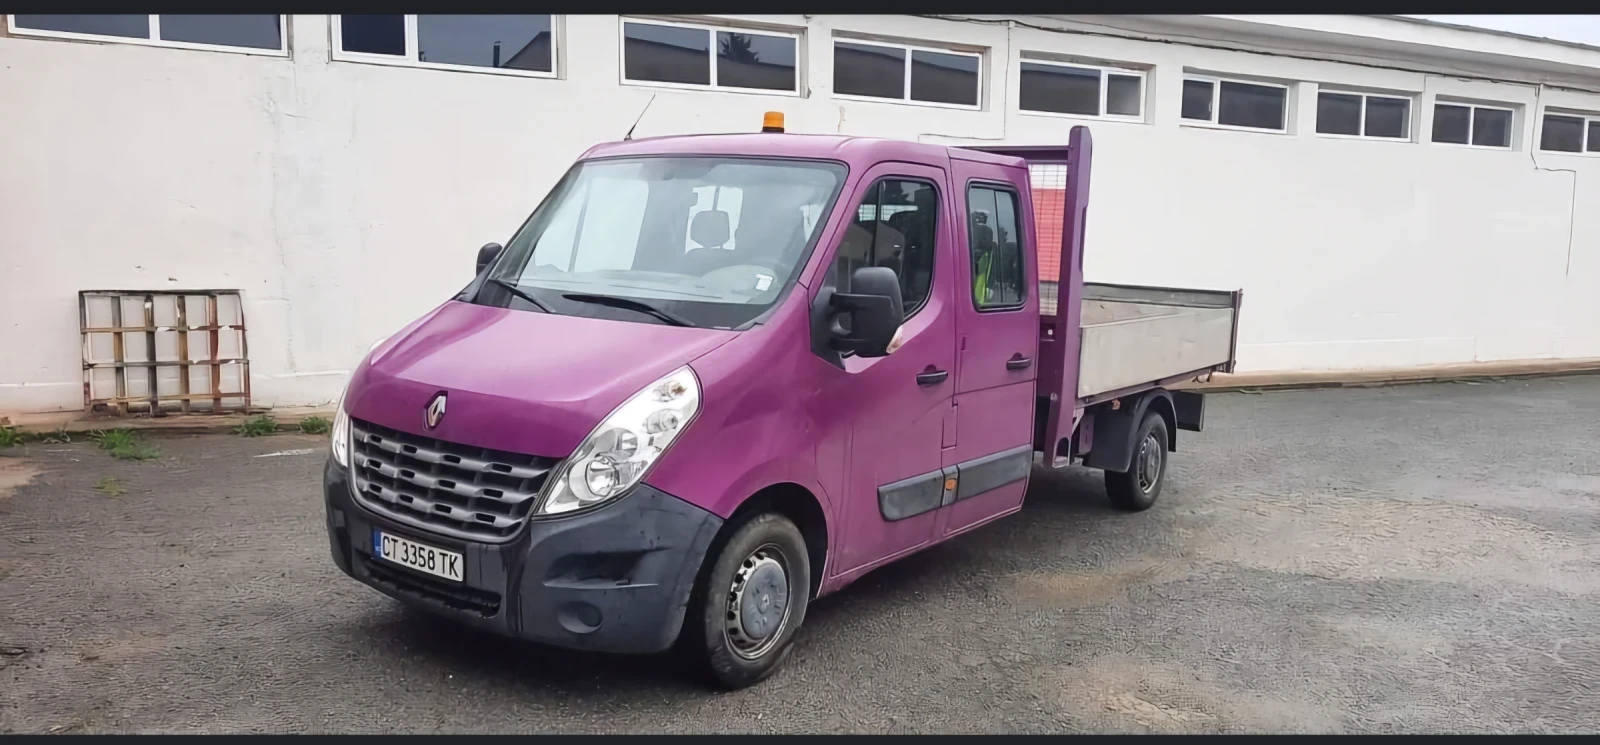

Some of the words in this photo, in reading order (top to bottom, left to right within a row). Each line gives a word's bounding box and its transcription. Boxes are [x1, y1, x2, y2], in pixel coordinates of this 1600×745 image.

[382, 536, 399, 560] CT
[401, 541, 436, 571] 3358
[438, 552, 459, 579] TK
